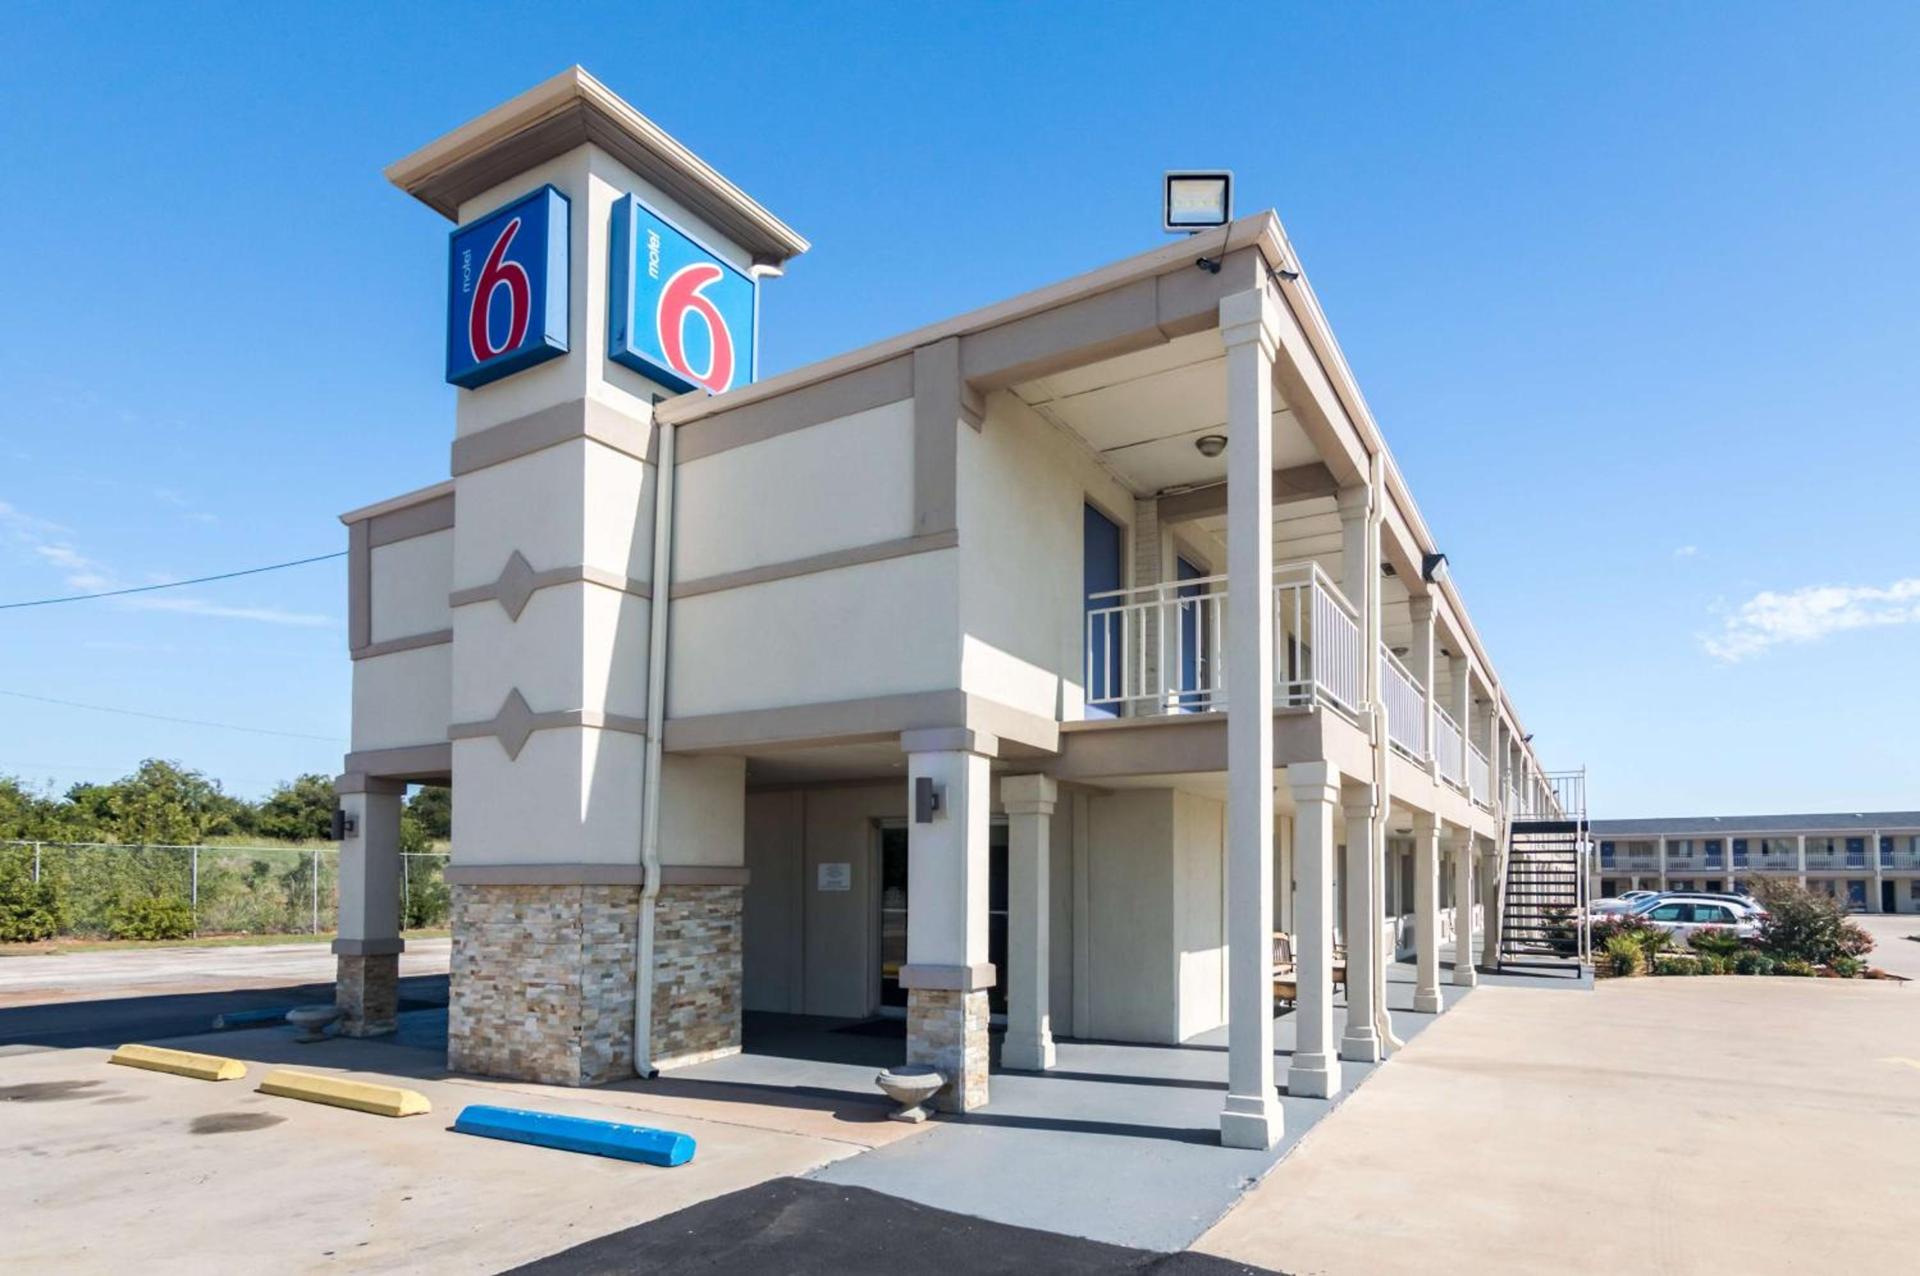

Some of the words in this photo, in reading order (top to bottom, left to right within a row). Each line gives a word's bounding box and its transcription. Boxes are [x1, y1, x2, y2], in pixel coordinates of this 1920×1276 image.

[462, 248, 472, 293] motel
[469, 217, 531, 363] 6
[648, 229, 660, 279] motel
[656, 262, 735, 396] 6
